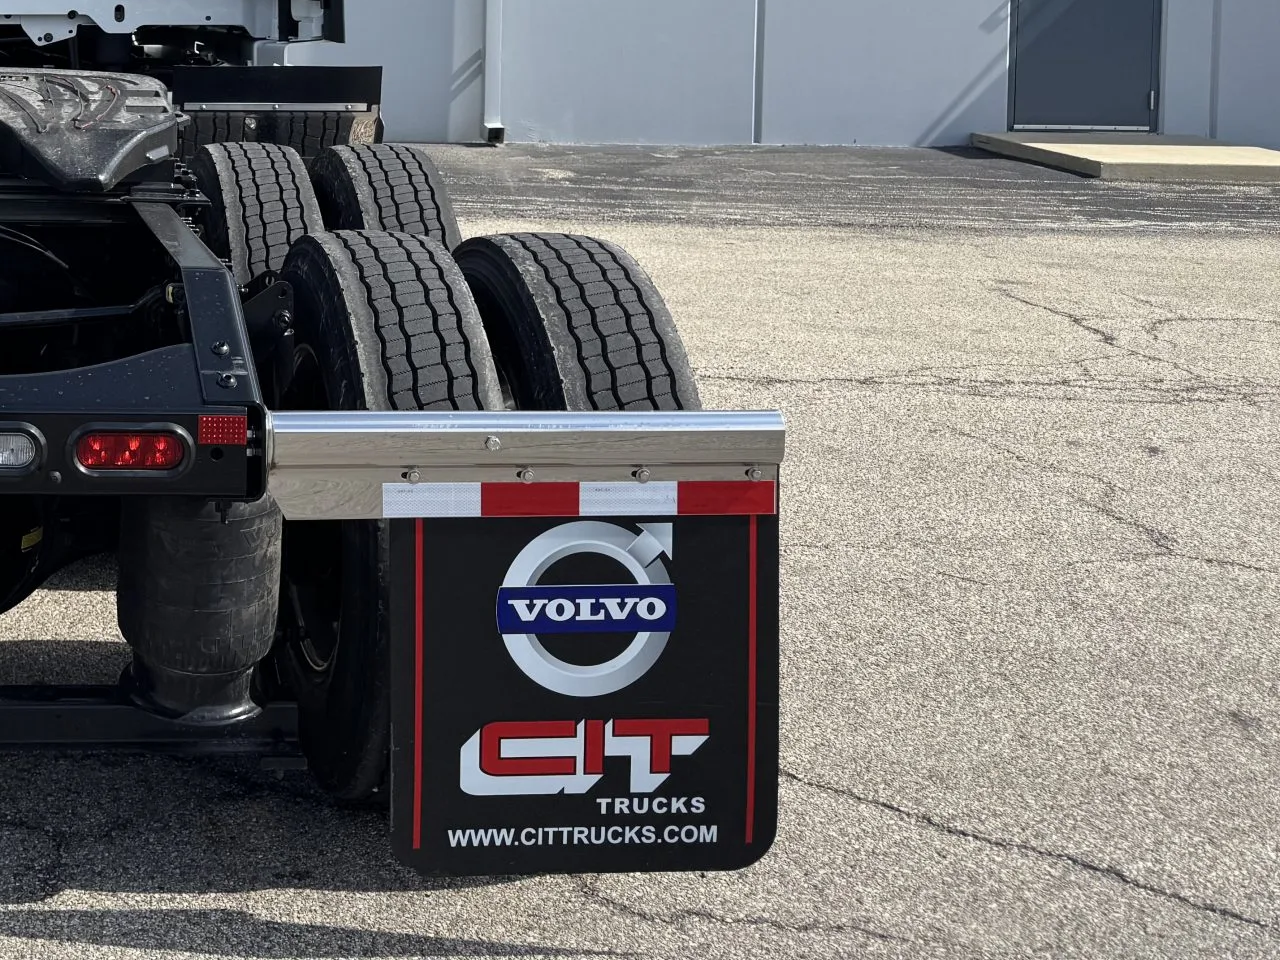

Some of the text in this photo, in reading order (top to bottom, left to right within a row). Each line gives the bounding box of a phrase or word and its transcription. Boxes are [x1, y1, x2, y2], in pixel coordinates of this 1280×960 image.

[507, 597, 667, 622] VOLVO
[460, 718, 710, 796] CIT
[596, 796, 706, 815] TRUCKS
[447, 825, 718, 848] WWW.CITTRUCKS.COM
